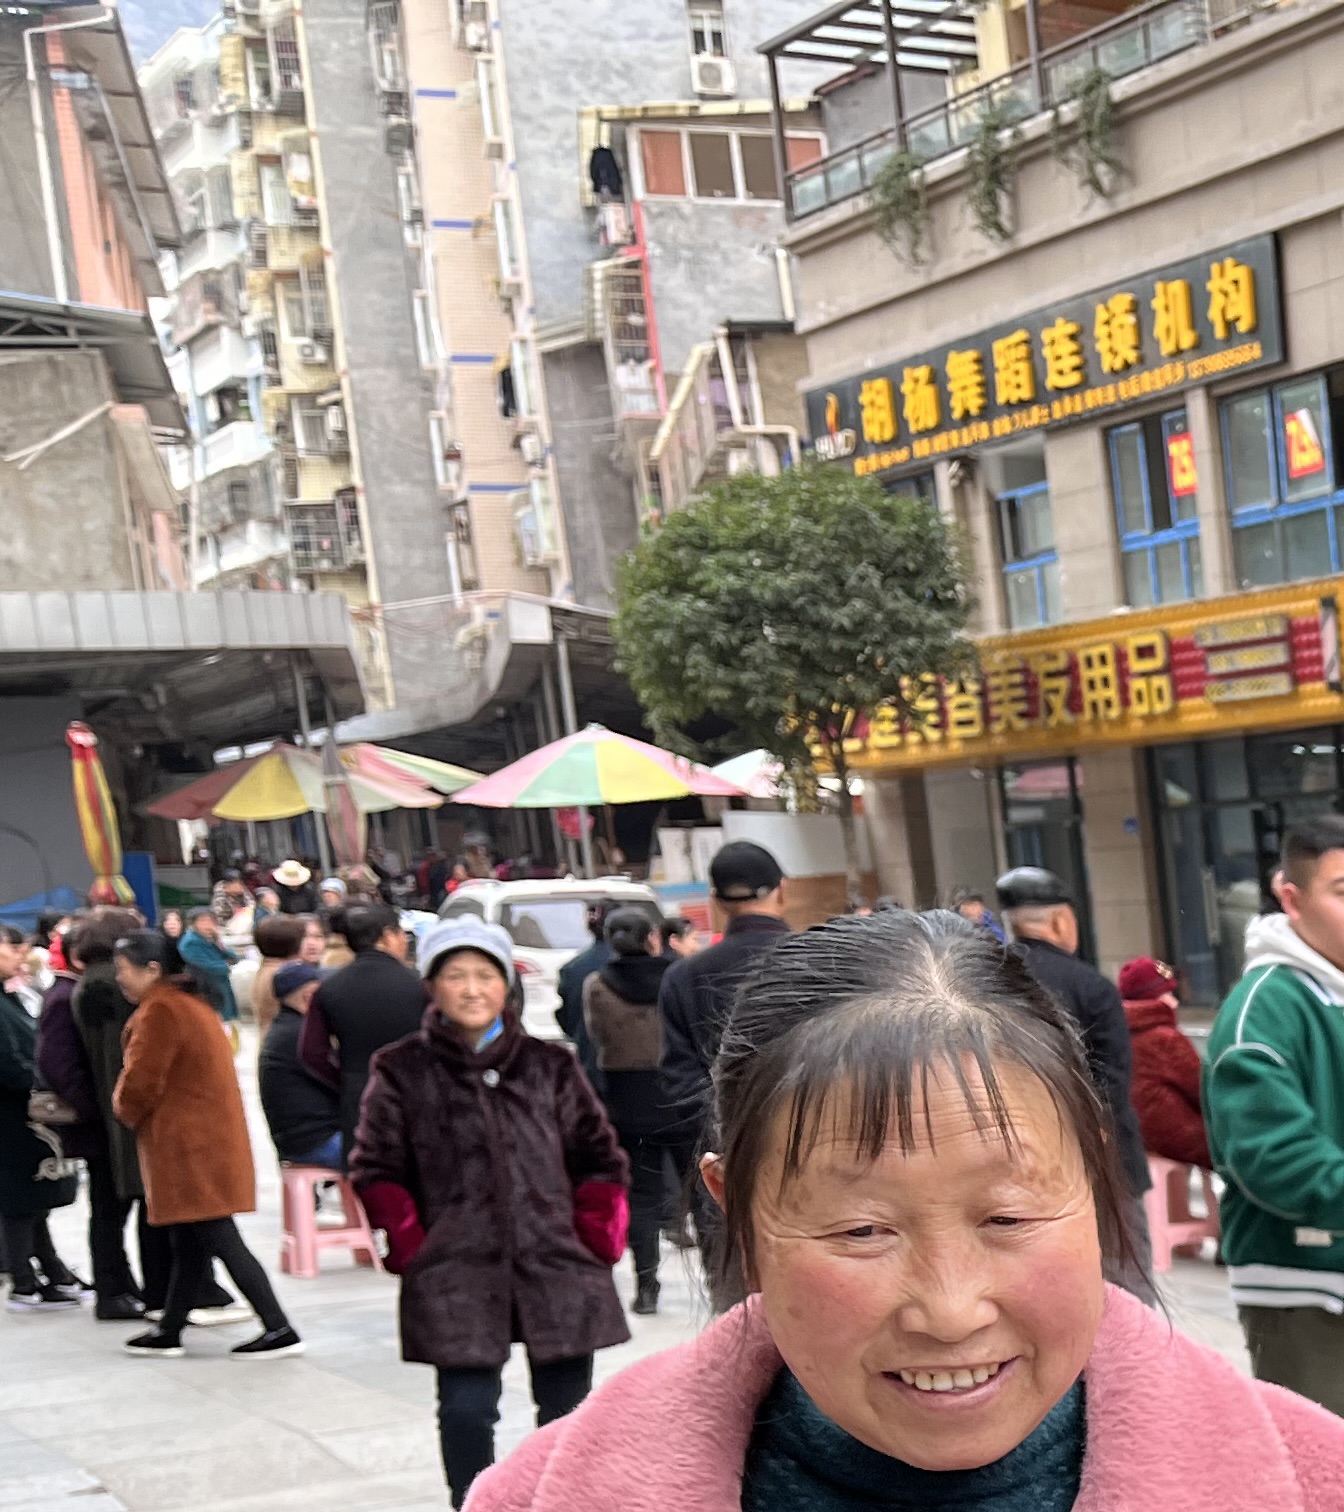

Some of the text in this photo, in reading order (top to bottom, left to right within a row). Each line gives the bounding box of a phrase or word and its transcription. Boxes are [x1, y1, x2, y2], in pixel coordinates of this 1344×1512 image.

[858, 256, 1259, 445] 胡杨舞蹈连锁机构
